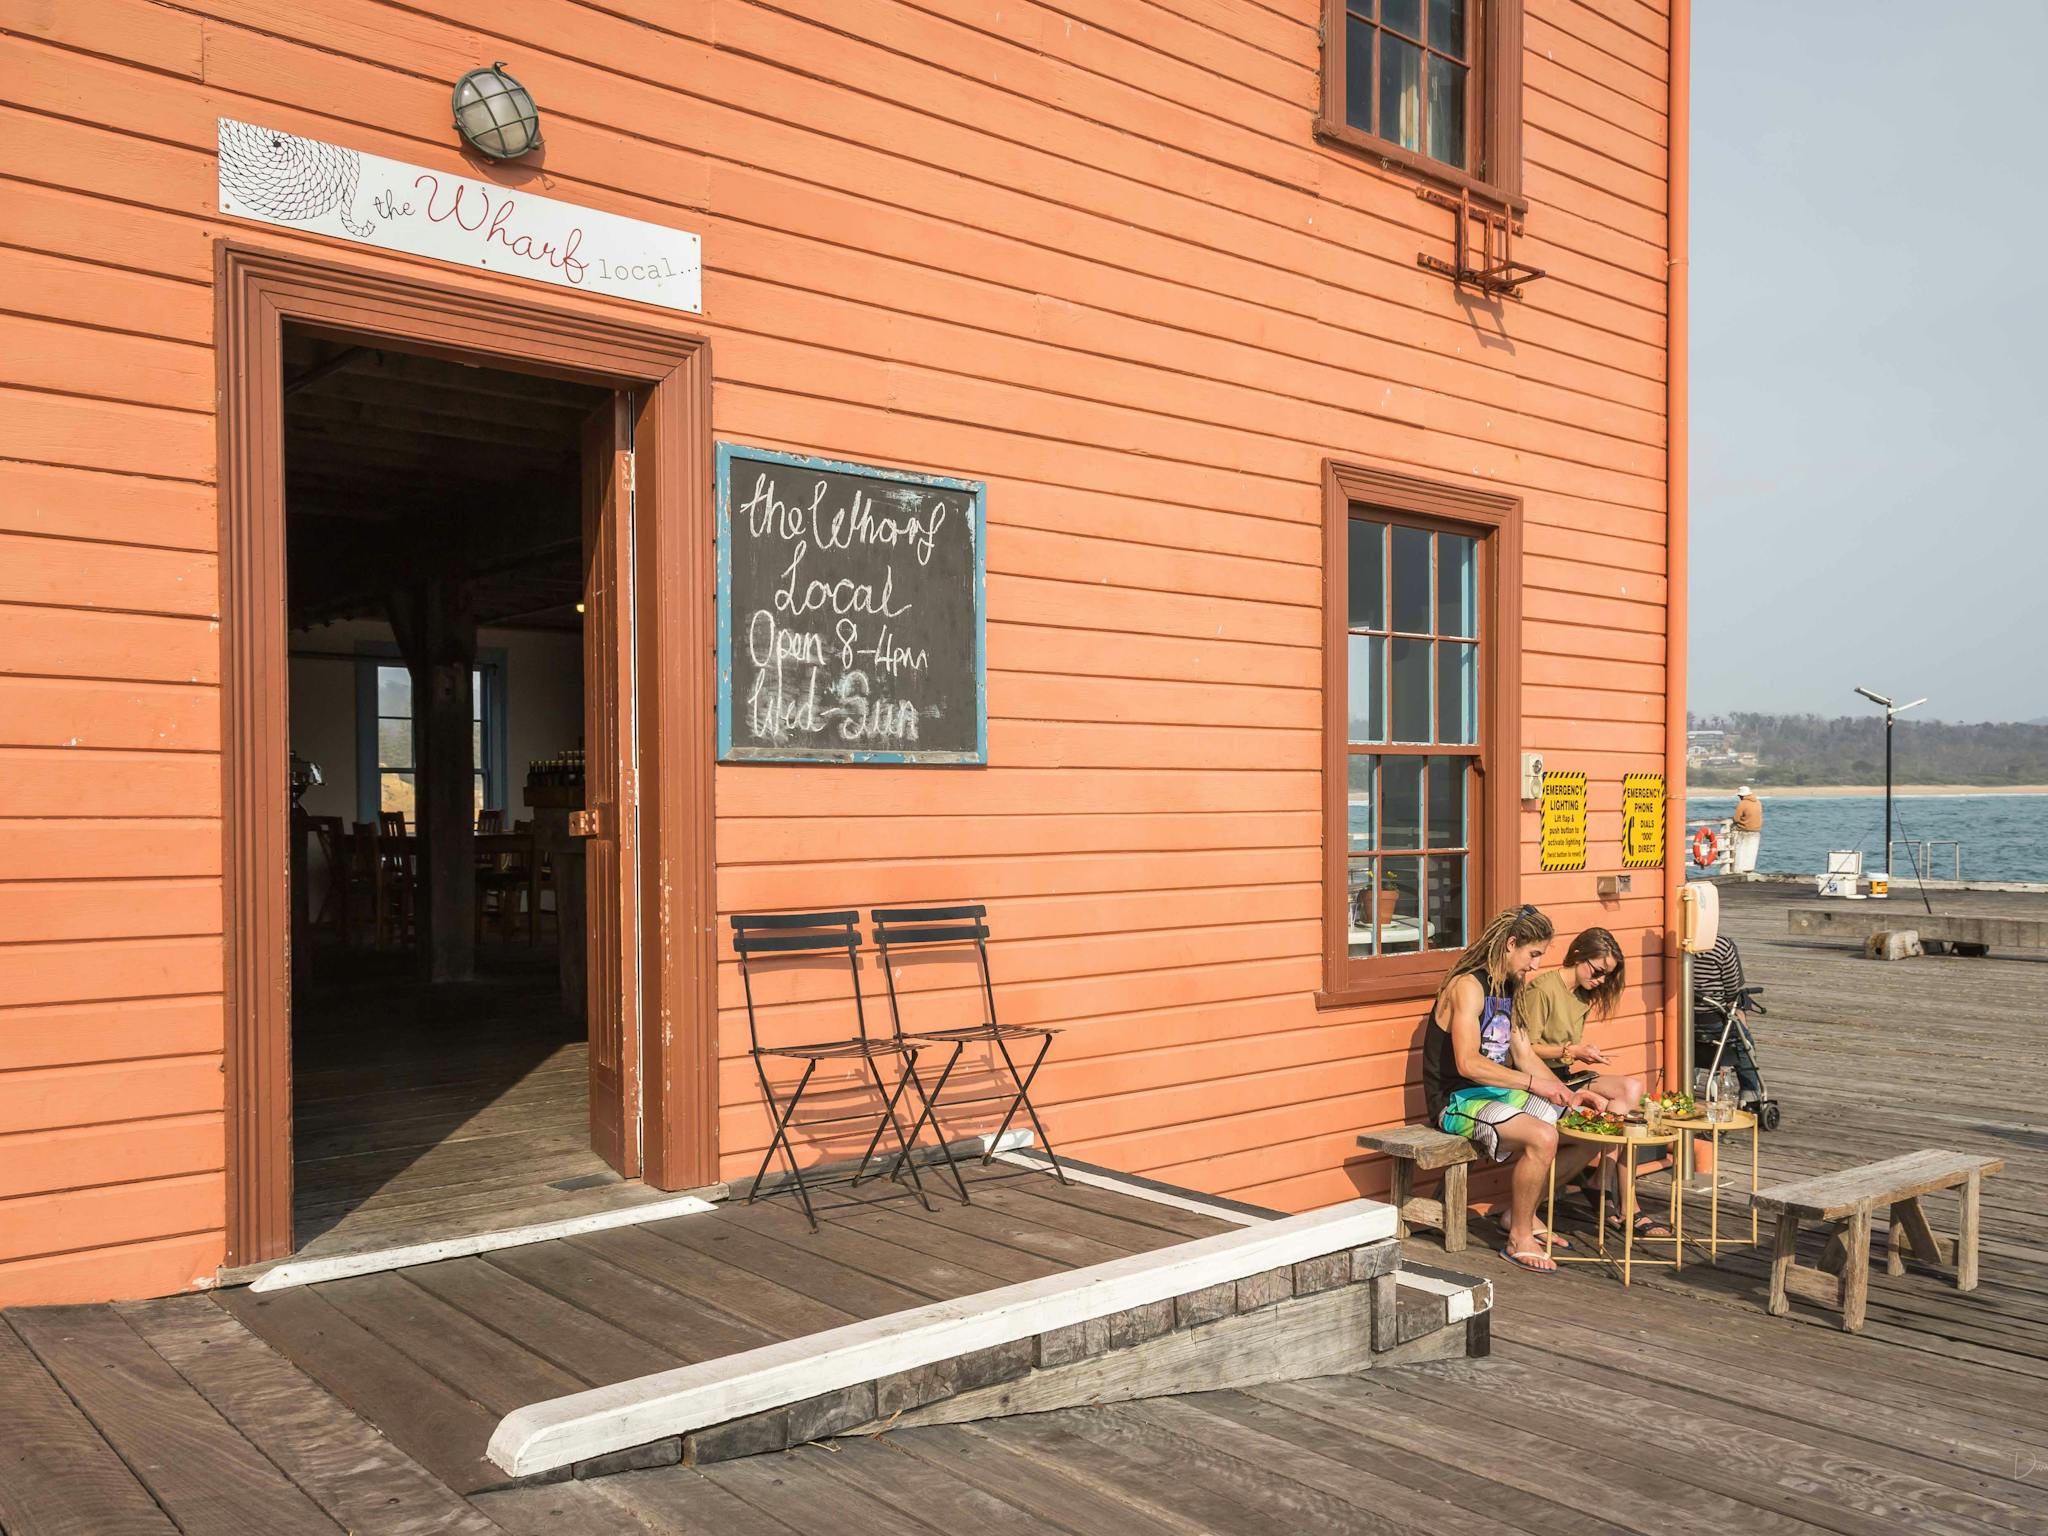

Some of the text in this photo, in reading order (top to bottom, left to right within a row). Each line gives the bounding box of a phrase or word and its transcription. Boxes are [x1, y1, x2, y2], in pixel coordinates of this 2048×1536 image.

[372, 188, 416, 221] the
[414, 174, 590, 284] Wharf
[740, 472, 946, 566] the Wharf
[774, 540, 913, 618] Local
[749, 609, 828, 690] Open
[1545, 784, 1584, 796] EMERGENCY
[1627, 787, 1661, 799] EMERGENCY
[1550, 800, 1579, 811] LIGHTING
[1634, 802, 1654, 813] PHONE
[1640, 819, 1655, 829] DIALS
[1549, 826, 1580, 836] push button to
[1547, 837, 1581, 848] activate lighting
[1637, 844, 1656, 854] DIRECT
